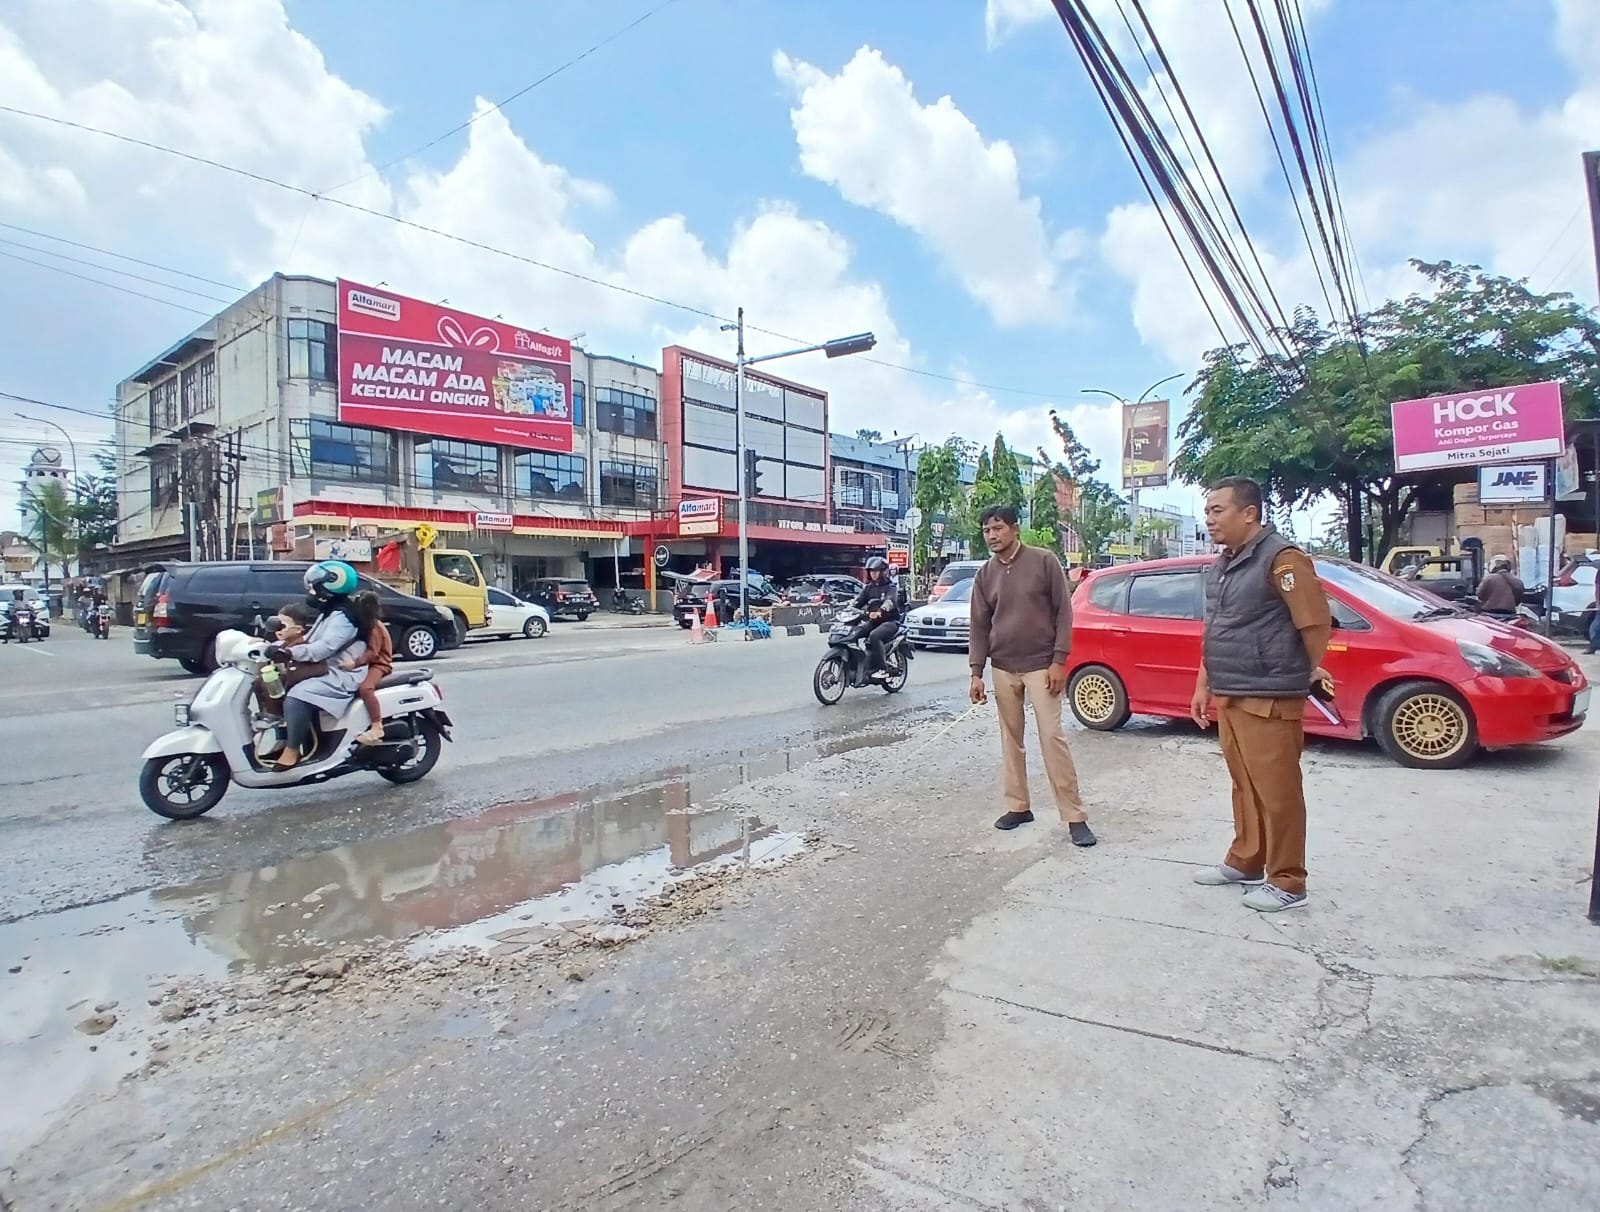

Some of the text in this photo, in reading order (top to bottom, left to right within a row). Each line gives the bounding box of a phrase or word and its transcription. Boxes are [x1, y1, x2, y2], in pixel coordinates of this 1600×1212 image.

[352, 293, 395, 312] Alfamart
[529, 341, 563, 357] Alfagift
[381, 346, 463, 372] MACAM
[352, 362, 487, 392] MACAM ADA
[351, 382, 490, 407] KECUALI ONGKIR
[1432, 392, 1518, 425] HOCK
[1434, 420, 1519, 438] Kompor Gas
[1447, 446, 1511, 460] Mitra Sejati
[1488, 470, 1539, 487] JNE
[681, 501, 716, 513] Alfamart
[477, 514, 512, 523] Alfamart
